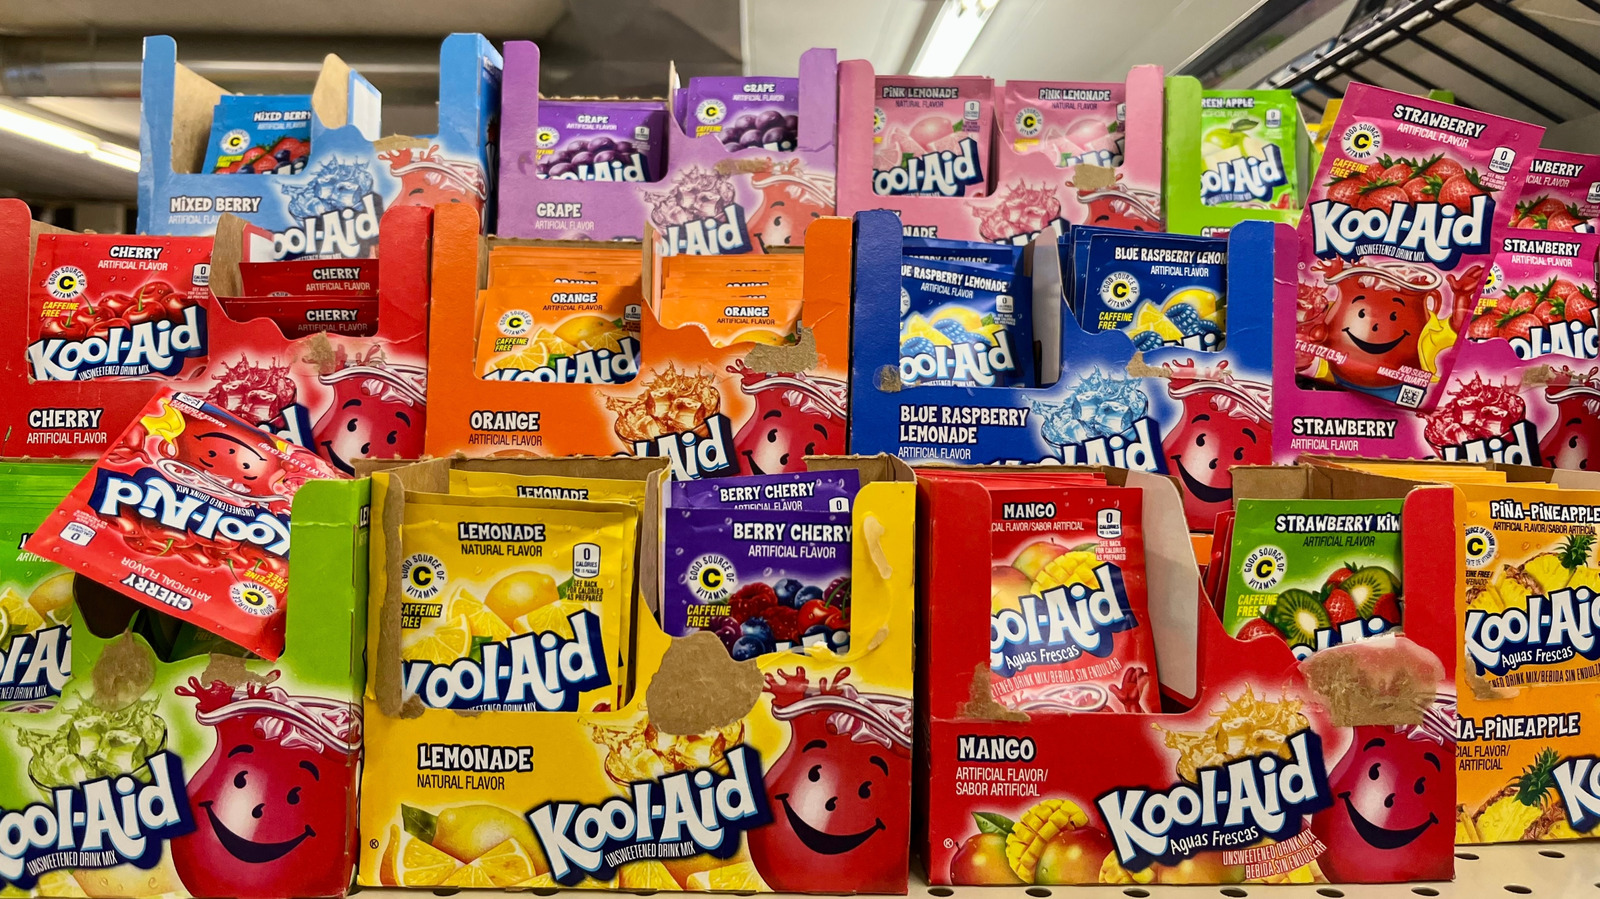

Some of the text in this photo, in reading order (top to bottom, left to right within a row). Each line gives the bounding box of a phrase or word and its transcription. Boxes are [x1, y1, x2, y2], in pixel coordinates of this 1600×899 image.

[744, 83, 775, 92] GRAPE
[908, 88, 958, 99] LEMONADE
[1063, 89, 1110, 100] LEMONADE
[1202, 97, 1254, 108] REEN APPLE
[578, 115, 609, 124] GRAPE
[1394, 104, 1486, 138] STRAWBERRY
[1354, 133, 1370, 149] C
[1397, 123, 1469, 148] ARTIFICIAL FLAVOR
[1501, 151, 1508, 160] 0
[873, 138, 977, 196] ool-Aid
[1332, 158, 1370, 174] CAFFEINE
[1491, 159, 1510, 168] CALORIES
[1329, 167, 1350, 178] FREE
[1543, 176, 1570, 188] FLAVOR
[216, 197, 261, 212] BERRY
[536, 202, 582, 218] GRAPE
[273, 194, 379, 259] ool-Aid
[535, 220, 594, 231] ARTIFICIAL FLAVOR
[1311, 196, 1487, 262] Kool-Aid
[109, 246, 162, 259] CHERRY
[1115, 247, 1195, 263] BLUE RASPBERRY
[1355, 243, 1425, 261] UNSWEETENED DRINK MIX
[1503, 239, 1580, 257] STRAWBERRY
[98, 260, 168, 271] ARTIFICIAL FLAVOR
[1511, 255, 1573, 268] ARTIFICIAL FLAVOR
[312, 267, 360, 280] CHERRY
[1150, 265, 1209, 277] ARTIFICIAL FLAVOR
[60, 276, 74, 290] C
[306, 282, 370, 291] ARTIFICIAL FLAVOR
[913, 267, 1007, 292] RASPBERRY LEMONADE
[920, 282, 974, 299] ARTIFICIAL FLAVOR
[1112, 283, 1127, 298] C
[43, 301, 79, 311] CAFFEINE
[551, 293, 598, 304] ORANGE
[41, 309, 61, 318] FREE
[306, 310, 358, 321] CHERRY
[724, 307, 769, 317] ORANGE
[1099, 311, 1133, 322] CAFFEINE
[298, 323, 368, 332] ARTIFICIAL FLAVOR
[1098, 321, 1117, 330] FREE
[28, 305, 201, 380] Kool-Aid
[900, 329, 1015, 387] ool-Aid
[1326, 349, 1347, 365] (3.9g)
[78, 364, 150, 380] UNSWEETENED DRINK MIX
[29, 409, 102, 428] CHERRY
[470, 411, 539, 431] ORANGE
[900, 405, 1029, 426] BLUE RASPBERRY
[900, 426, 977, 444] LEMONADE
[1292, 418, 1396, 438] STRAWBERRY
[26, 432, 107, 444] ARTIFICIAL FLAVOR
[468, 433, 542, 446] ARTIFICIAL FLAVOR
[1290, 439, 1358, 451] ARTIFICIAL FLAVOR
[898, 447, 971, 460] ARTIFICIAL FLAVOR
[176, 484, 211, 503] DRINK MIX
[518, 486, 588, 500] LEMONADE
[720, 482, 815, 501] BERRY CHERRY
[1004, 503, 1055, 519] MANGO
[1106, 512, 1112, 523] 0
[1005, 522, 1052, 532] FLAVOR/SABOR
[1053, 521, 1084, 531] ARTIFICIAL
[1276, 515, 1374, 532] STRAWBERRY
[1493, 522, 1597, 535] ARTIFICIAL FLAVOR/SABOR ARTIFICIAL
[459, 523, 545, 541] LEMONADE
[734, 523, 852, 542] BERRY CHERRY
[1303, 536, 1375, 547] ARTIFICIAL FLAVOR
[461, 543, 542, 557] NATURAL FLAVOR
[583, 547, 590, 560] 0
[748, 545, 836, 558] ARTIFICIAL FLAVOR
[121, 556, 211, 602] ARTIFICIAL FLAVOR
[121, 573, 193, 611] CHERRY
[1238, 595, 1278, 605] CAFFEINE
[687, 604, 731, 616] CAFFEINE
[1236, 606, 1258, 617] FREE
[687, 616, 710, 627] FREE
[1005, 644, 1079, 670] Aguas Frescas
[1501, 646, 1573, 668] Aguas Frescas
[1014, 657, 1122, 688] DRINK MIX/BEBIDA SIN ENDULZAR
[959, 737, 1035, 760] MANGO
[1474, 745, 1511, 757] FLAVOR/
[420, 744, 531, 769] LEMONADE
[1459, 759, 1503, 771] ARTIFICIAL
[955, 767, 1048, 781] ARTIFICIAL FLAVOR/
[417, 774, 505, 790] NATURAL FLAVOR
[955, 782, 1040, 797] SABOR ARTIFICIAL
[1099, 732, 1317, 863] Kool-Aid
[0, 752, 181, 880] ool-Aid
[529, 746, 758, 880] Kool-Aid
[1170, 826, 1259, 855] Aguas Frescas
[1222, 828, 1317, 866] UNSWEETENED DRINK MIX
[605, 840, 696, 868] UNSWEETENED DRINK MIX
[1246, 839, 1327, 879] BEBIDA SIN ENDULZAR
[27, 850, 118, 876] UNSWEETENED DRINK MIX
